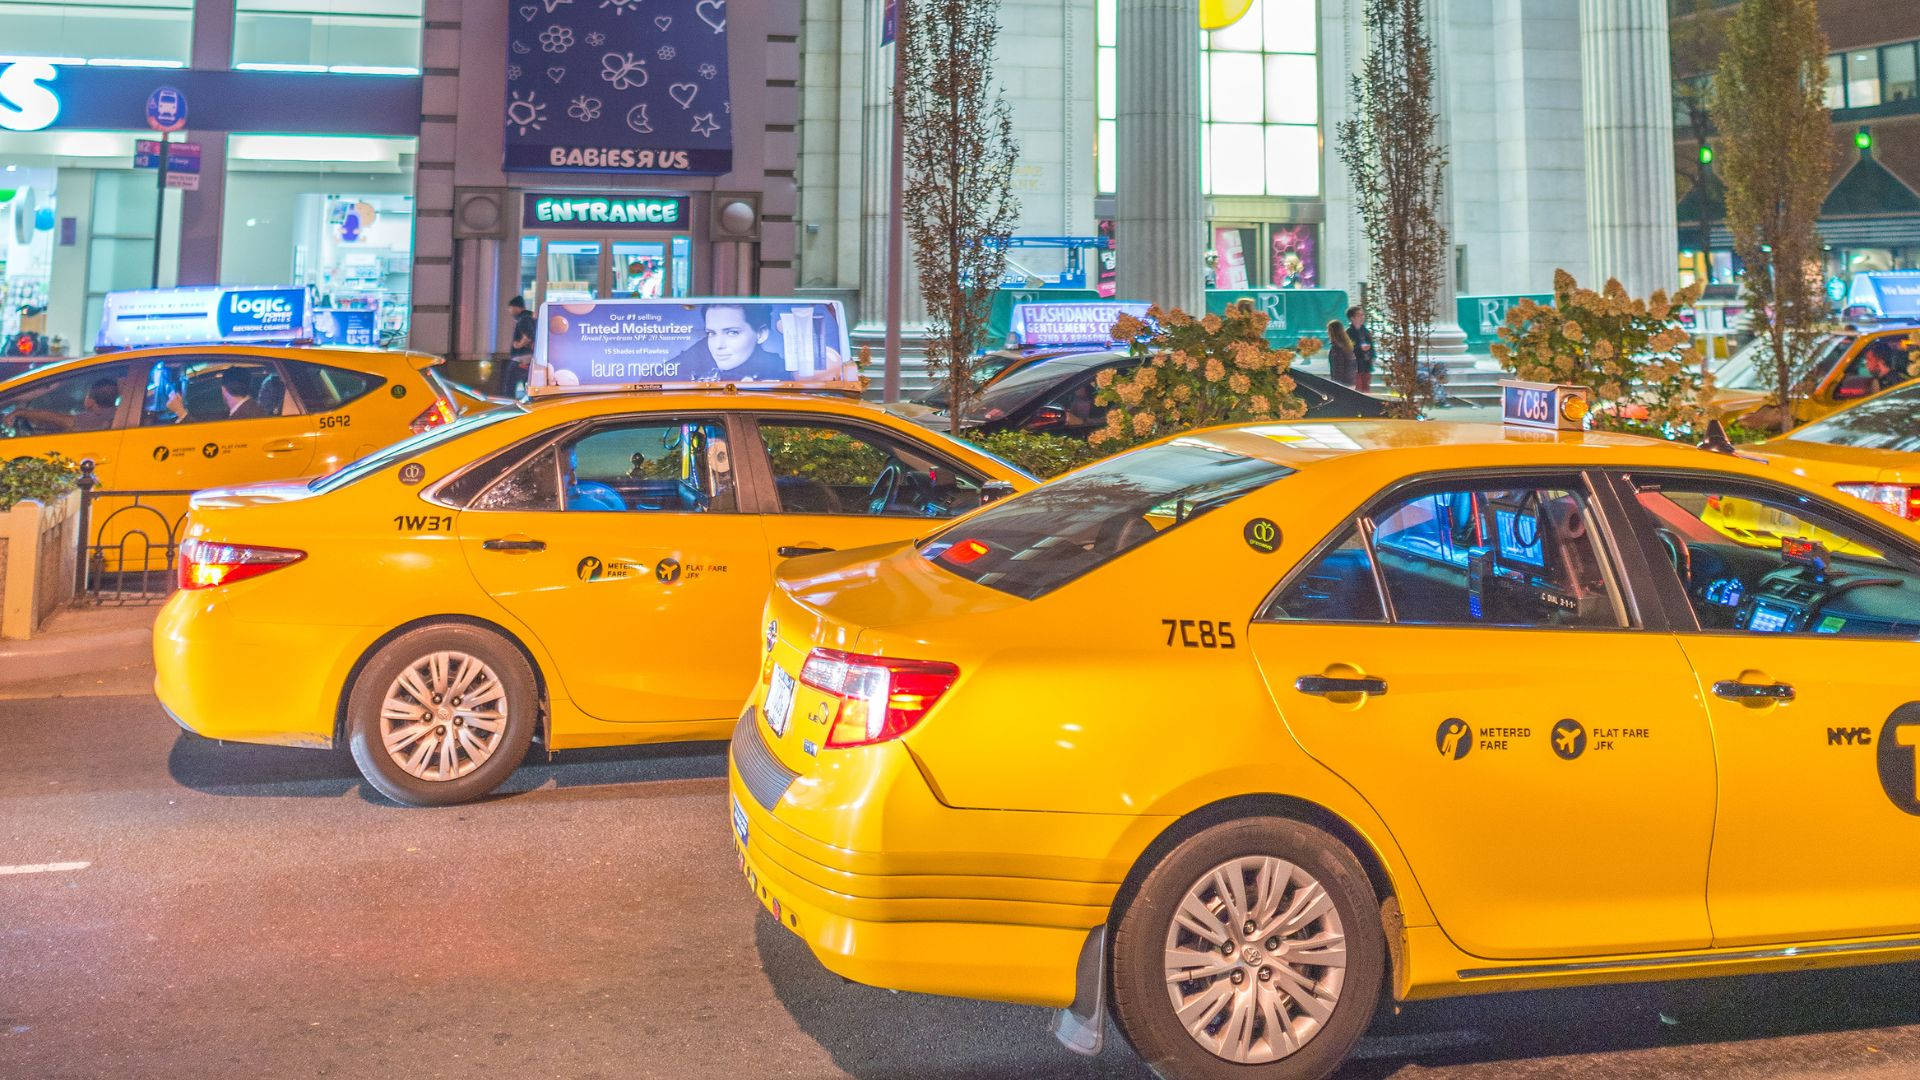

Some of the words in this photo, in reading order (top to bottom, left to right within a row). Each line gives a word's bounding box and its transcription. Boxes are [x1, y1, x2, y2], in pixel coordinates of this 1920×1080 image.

[658, 151, 689, 169] US
[537, 198, 678, 223] ENTRANCE
[609, 313, 625, 321] Our
[626, 313, 636, 321] #1
[637, 313, 662, 322] selling
[1480, 299, 1504, 326] R
[578, 322, 619, 334] Tinted
[622, 322, 694, 334] Moisturizer
[1027, 322, 1097, 334] GENTLEMEN'S
[643, 347, 669, 355] Flawless
[591, 359, 625, 378] laura
[627, 359, 680, 377] mercier
[1517, 389, 1548, 421] 7C85
[319, 415, 351, 429] 5G92
[394, 515, 452, 531] 1W31
[686, 564, 704, 572] FLAT
[1161, 618, 1236, 649] 7C85
[1479, 727, 1531, 738] METERED
[1593, 728, 1619, 738] FLAT
[1622, 728, 1649, 738] FARE
[1827, 727, 1872, 746] NYC
[1479, 740, 1508, 751] FARE
[1593, 741, 1614, 751] JFK
